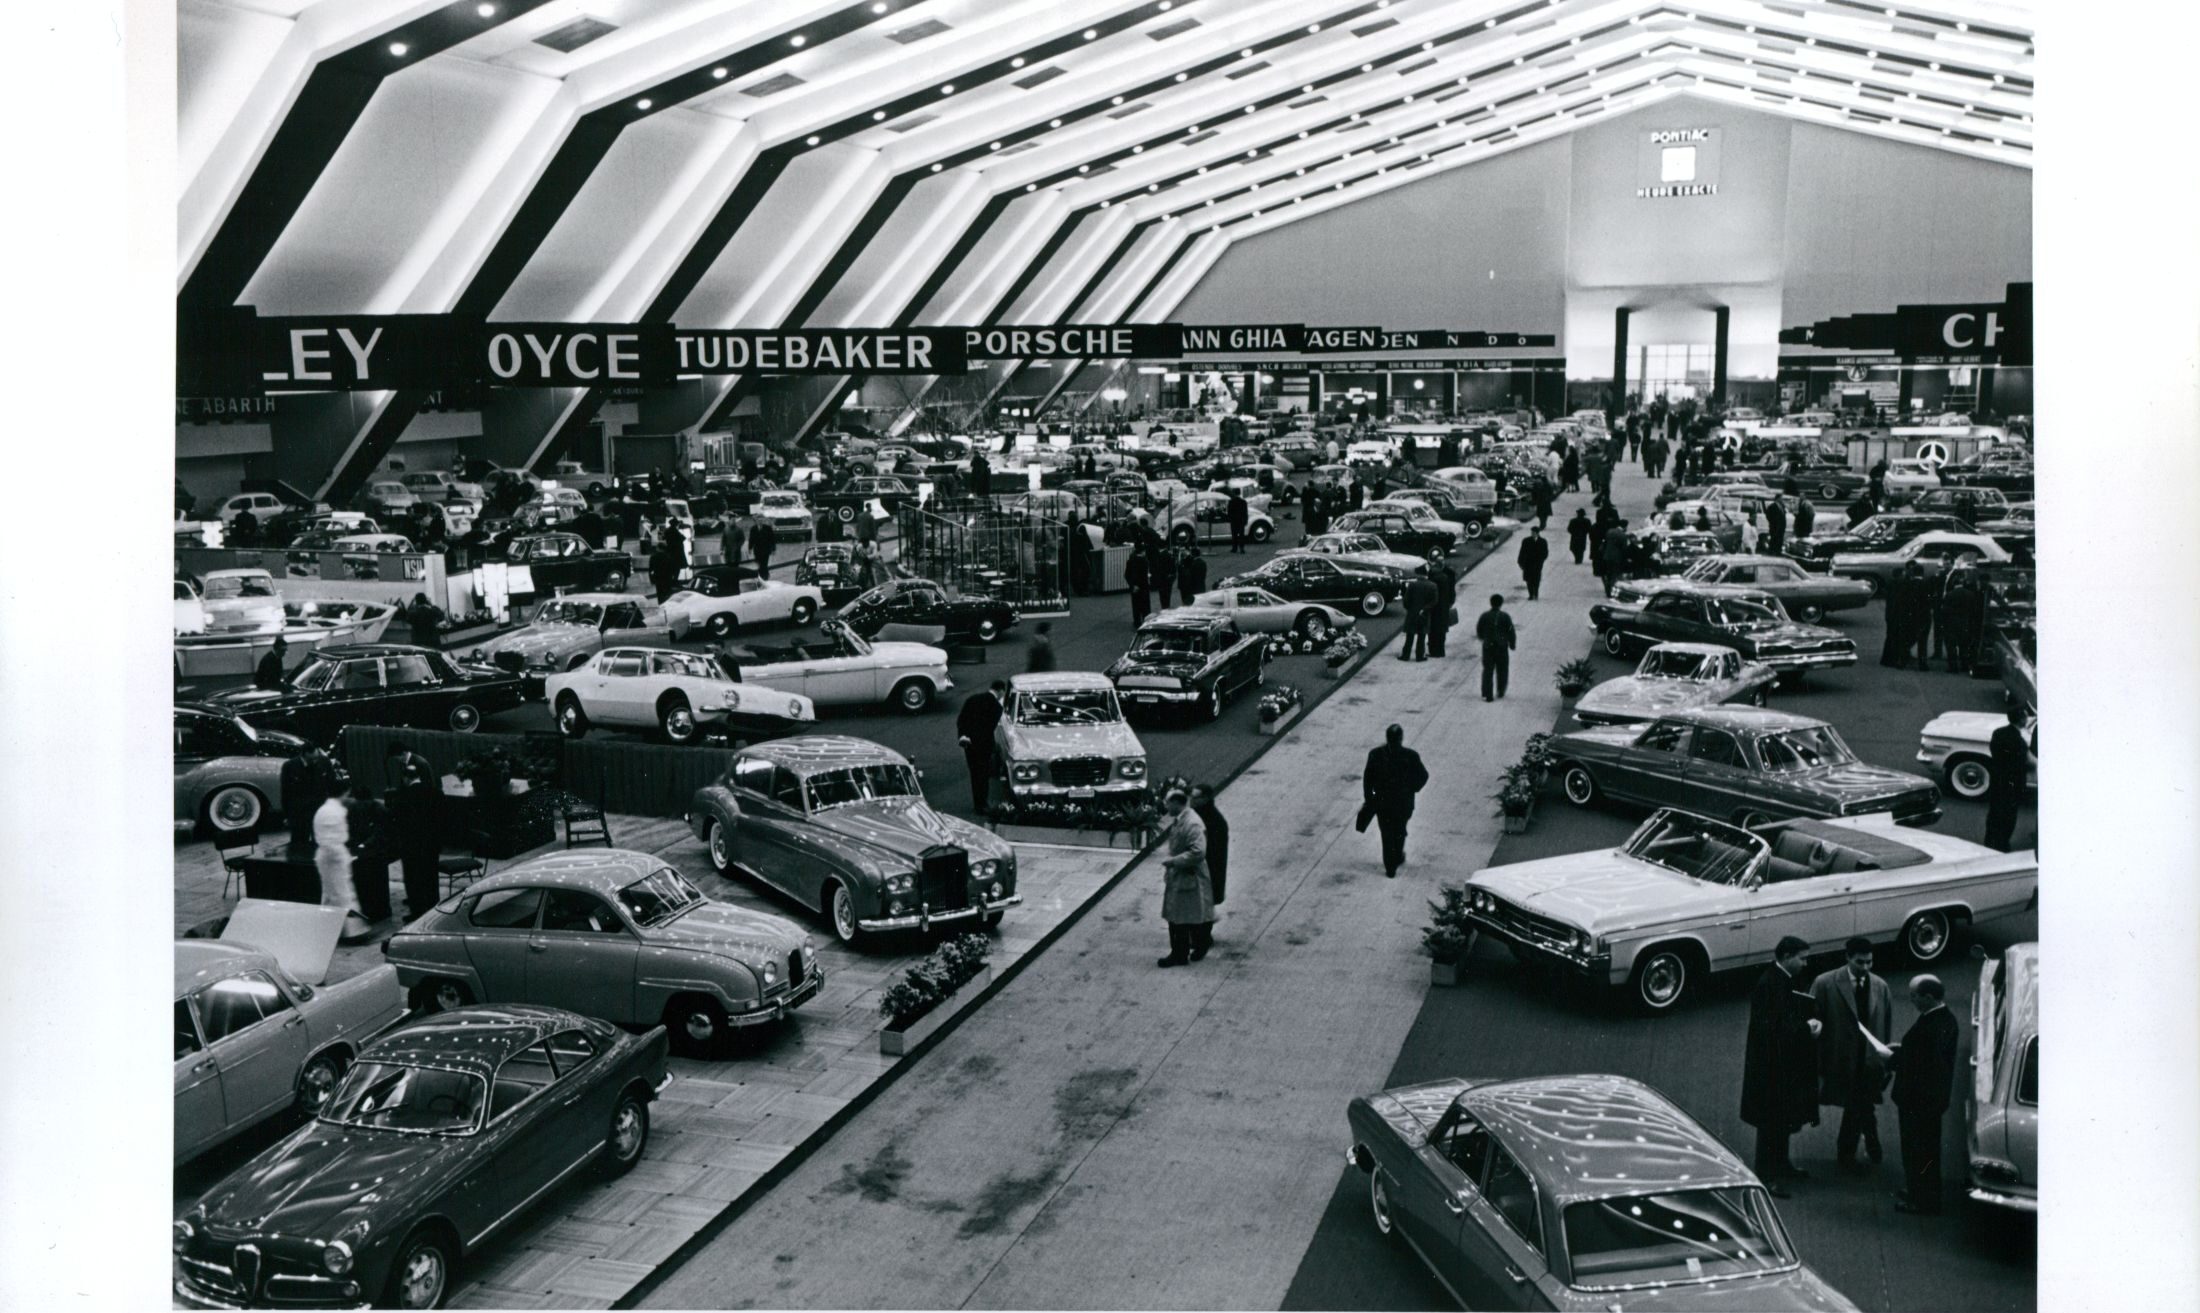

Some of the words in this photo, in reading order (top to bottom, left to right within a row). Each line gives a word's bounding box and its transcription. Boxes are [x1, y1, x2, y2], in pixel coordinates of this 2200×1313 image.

[1651, 129, 1709, 144] PONTIAC
[1677, 184, 1718, 196] EXACTE
[966, 329, 1133, 355] PORSCHE
[1230, 328, 1287, 348] GHIA
[1304, 330, 1375, 348] AGEN
[488, 333, 640, 379] OYCE
[675, 335, 934, 369] TUDEBAKER
[203, 396, 276, 414] ABARTH
